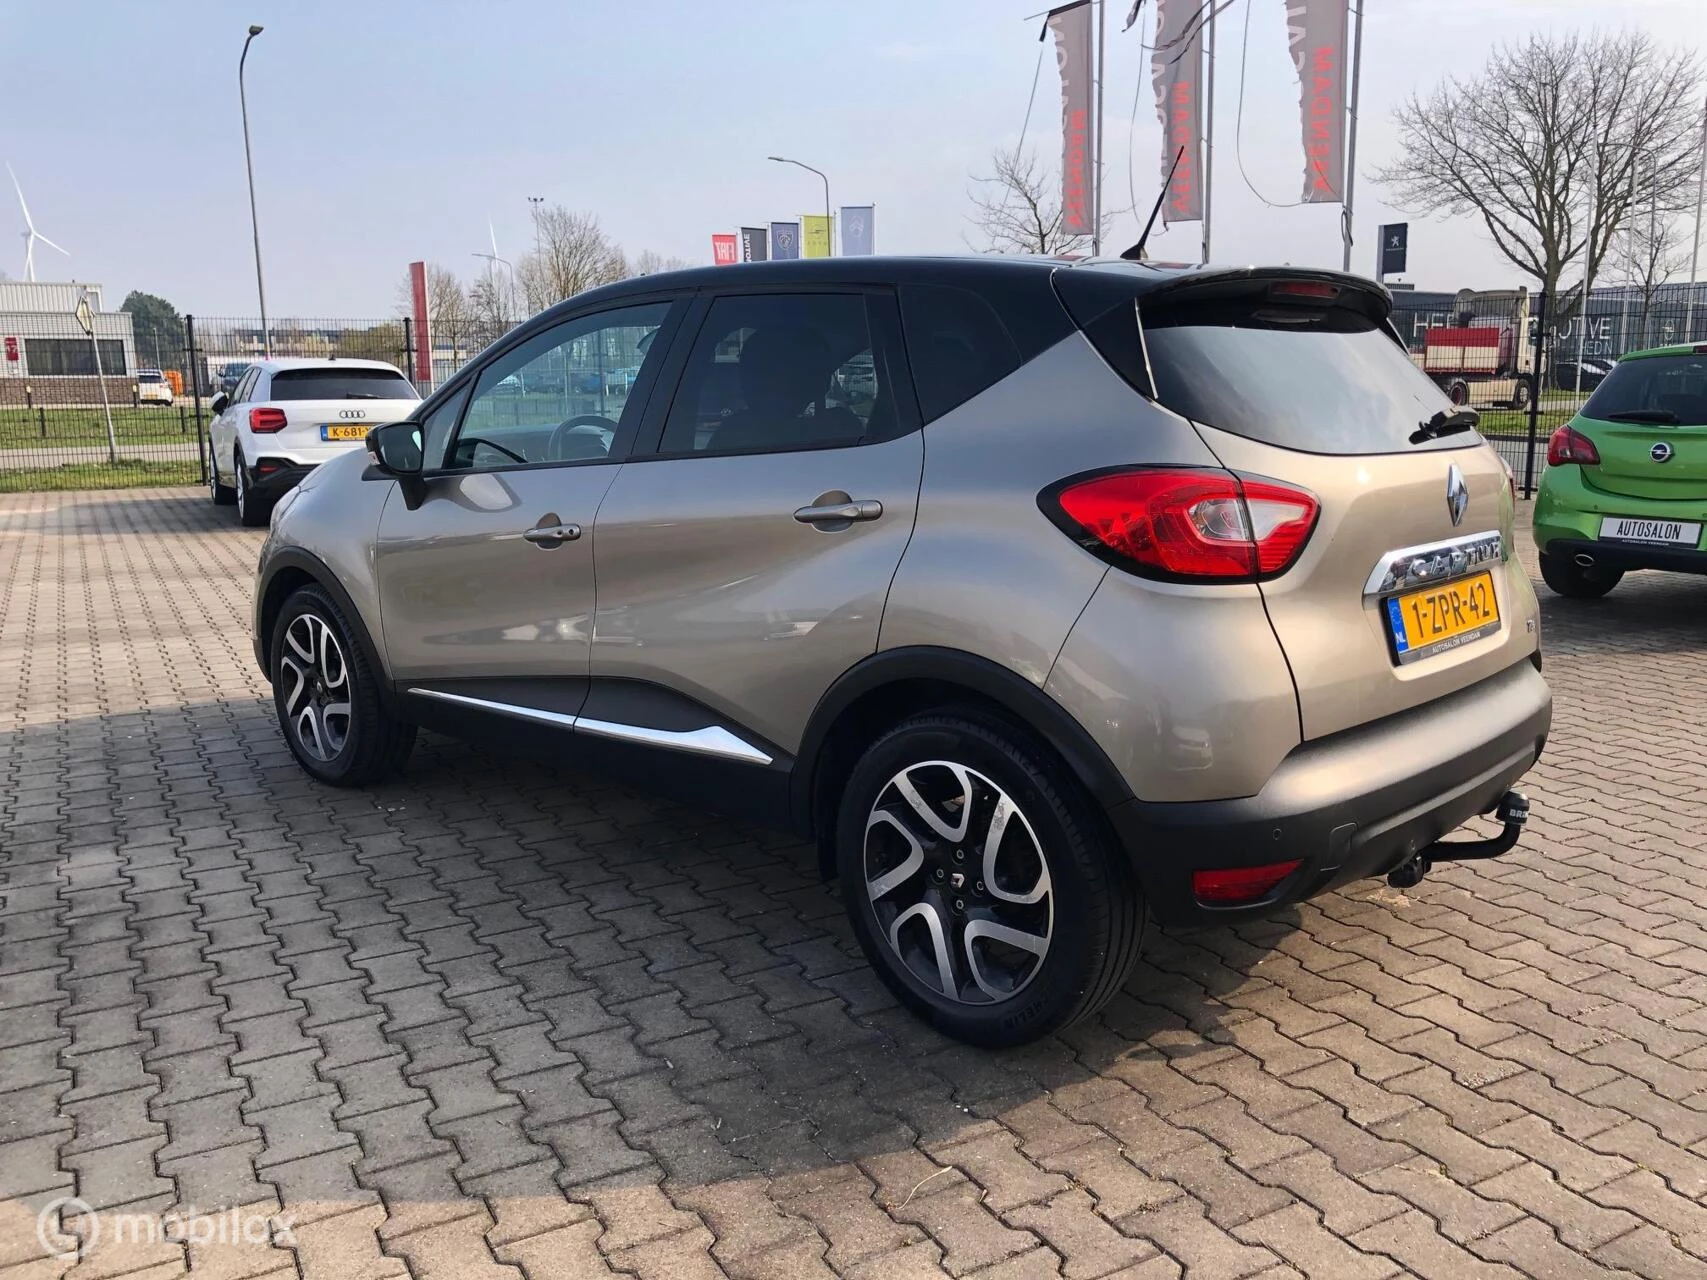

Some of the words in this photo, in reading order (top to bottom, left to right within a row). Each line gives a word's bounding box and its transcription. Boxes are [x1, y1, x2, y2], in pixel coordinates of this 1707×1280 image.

[1616, 520, 1682, 540] AUTOSALON
[1411, 583, 1490, 638] 1-ZPR-42
[1395, 631, 1406, 644] NL
[1432, 637, 1460, 654] AUTOSALON
